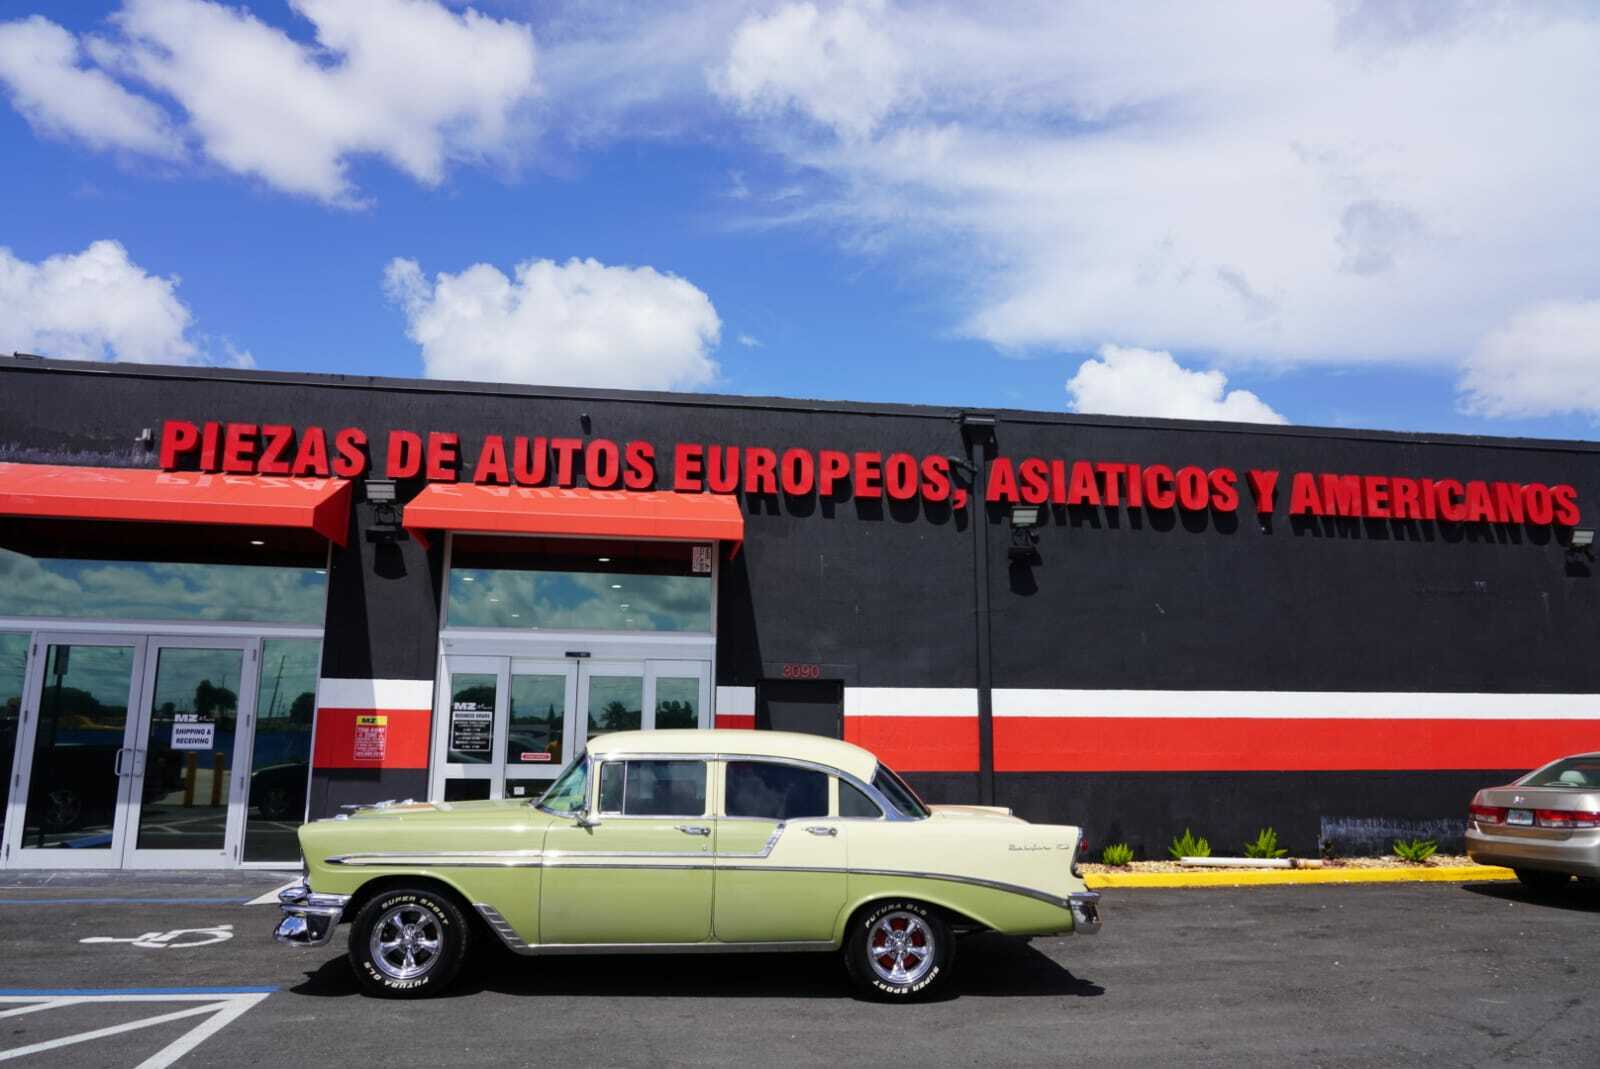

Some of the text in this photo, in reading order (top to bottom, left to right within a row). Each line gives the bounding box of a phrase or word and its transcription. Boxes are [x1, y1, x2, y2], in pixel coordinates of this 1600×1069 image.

[159, 420, 1581, 527] PIEZAS DE AUTOS EUROPEOS, ASIATICOS Y AMERICANOS
[382, 895, 449, 925] SUPER SPORT
[384, 976, 429, 989] FUTURA
[872, 966, 940, 994] SUPER SPORT
